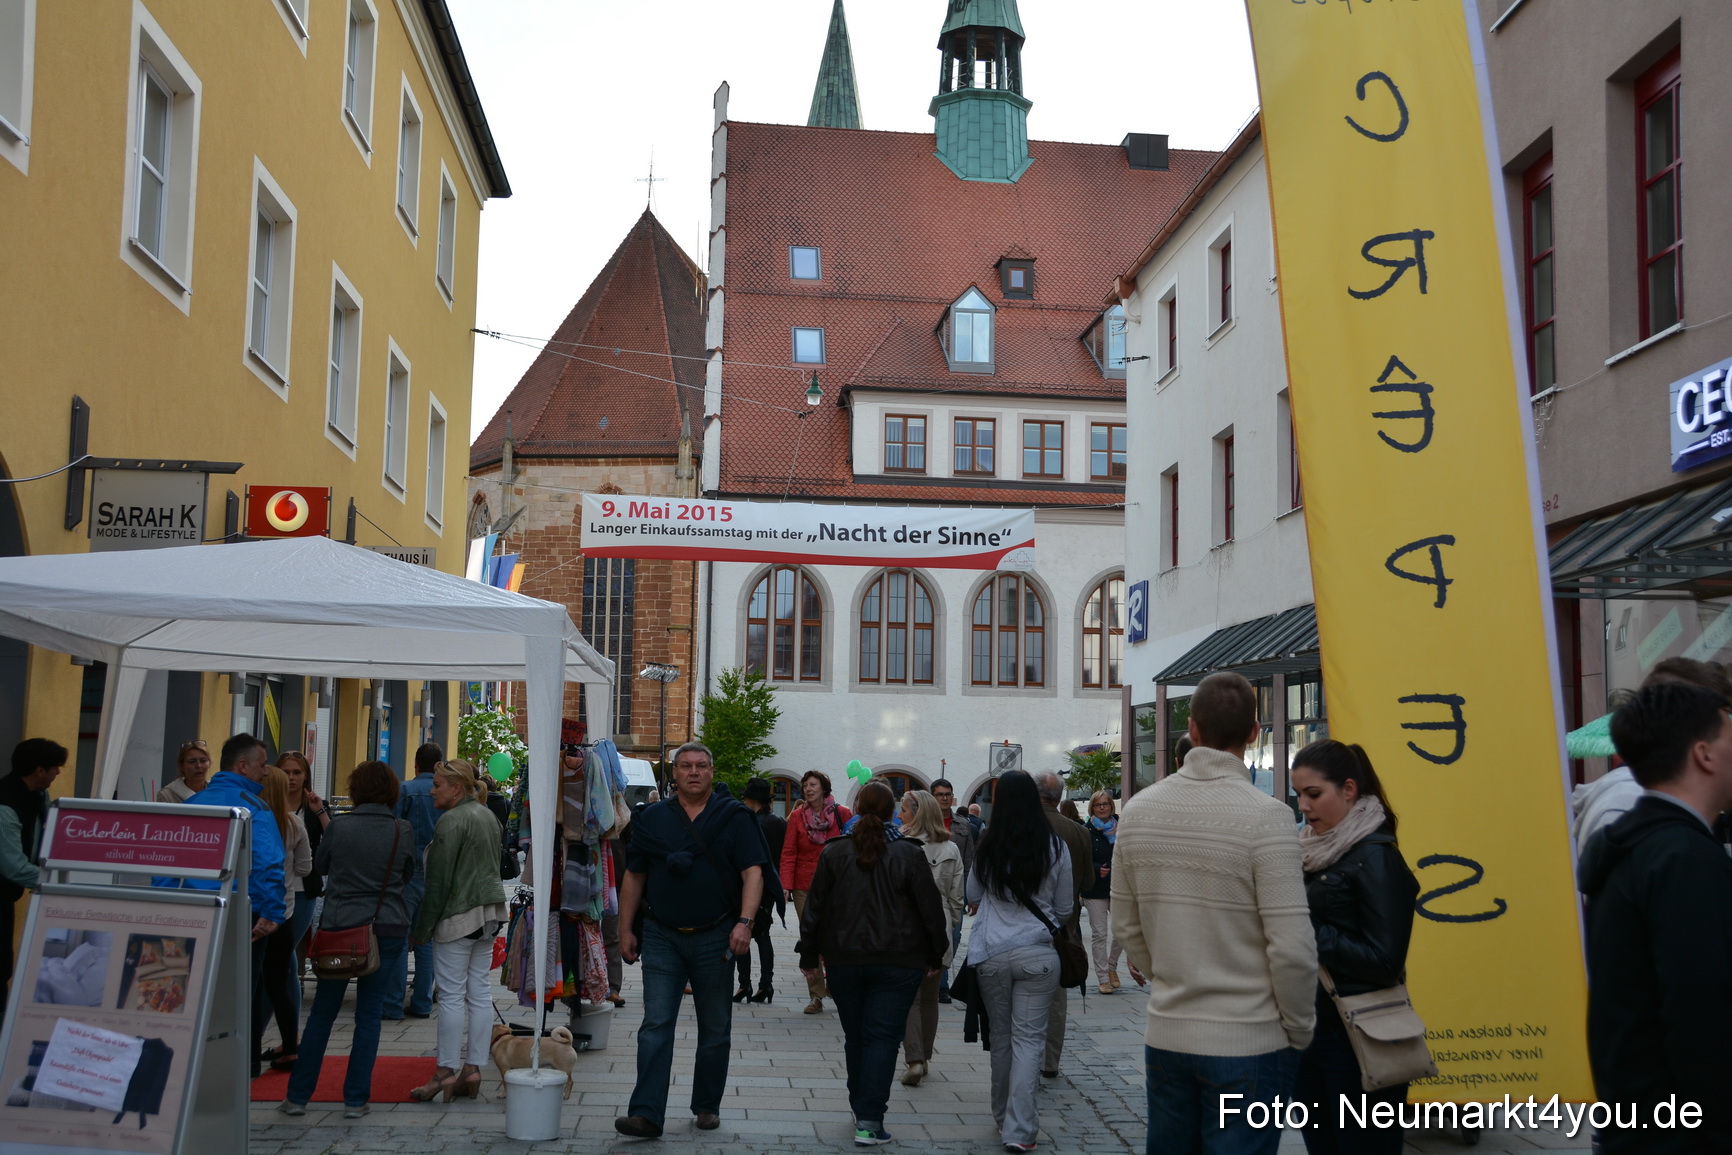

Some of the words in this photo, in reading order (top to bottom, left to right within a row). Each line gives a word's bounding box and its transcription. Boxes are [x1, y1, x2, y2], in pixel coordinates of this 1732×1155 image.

[98, 502, 174, 528] SARAH
[180, 504, 197, 528] K
[601, 500, 622, 518] 9.
[628, 501, 670, 519] Mai
[677, 504, 733, 522] 2015
[96, 528, 128, 538] MODE
[130, 528, 138, 538] &
[141, 529, 197, 540] LIFESTYLE
[590, 522, 637, 537] Langer
[640, 523, 753, 541] Einkaufssamstag
[756, 528, 778, 539] mit
[781, 528, 803, 540] der
[893, 525, 932, 544] der
[61, 815, 137, 841] Enderlein
[141, 823, 221, 845] Landhaus
[105, 849, 135, 860] stilvoll
[139, 851, 175, 862] wohnen
[136, 914, 152, 924] und
